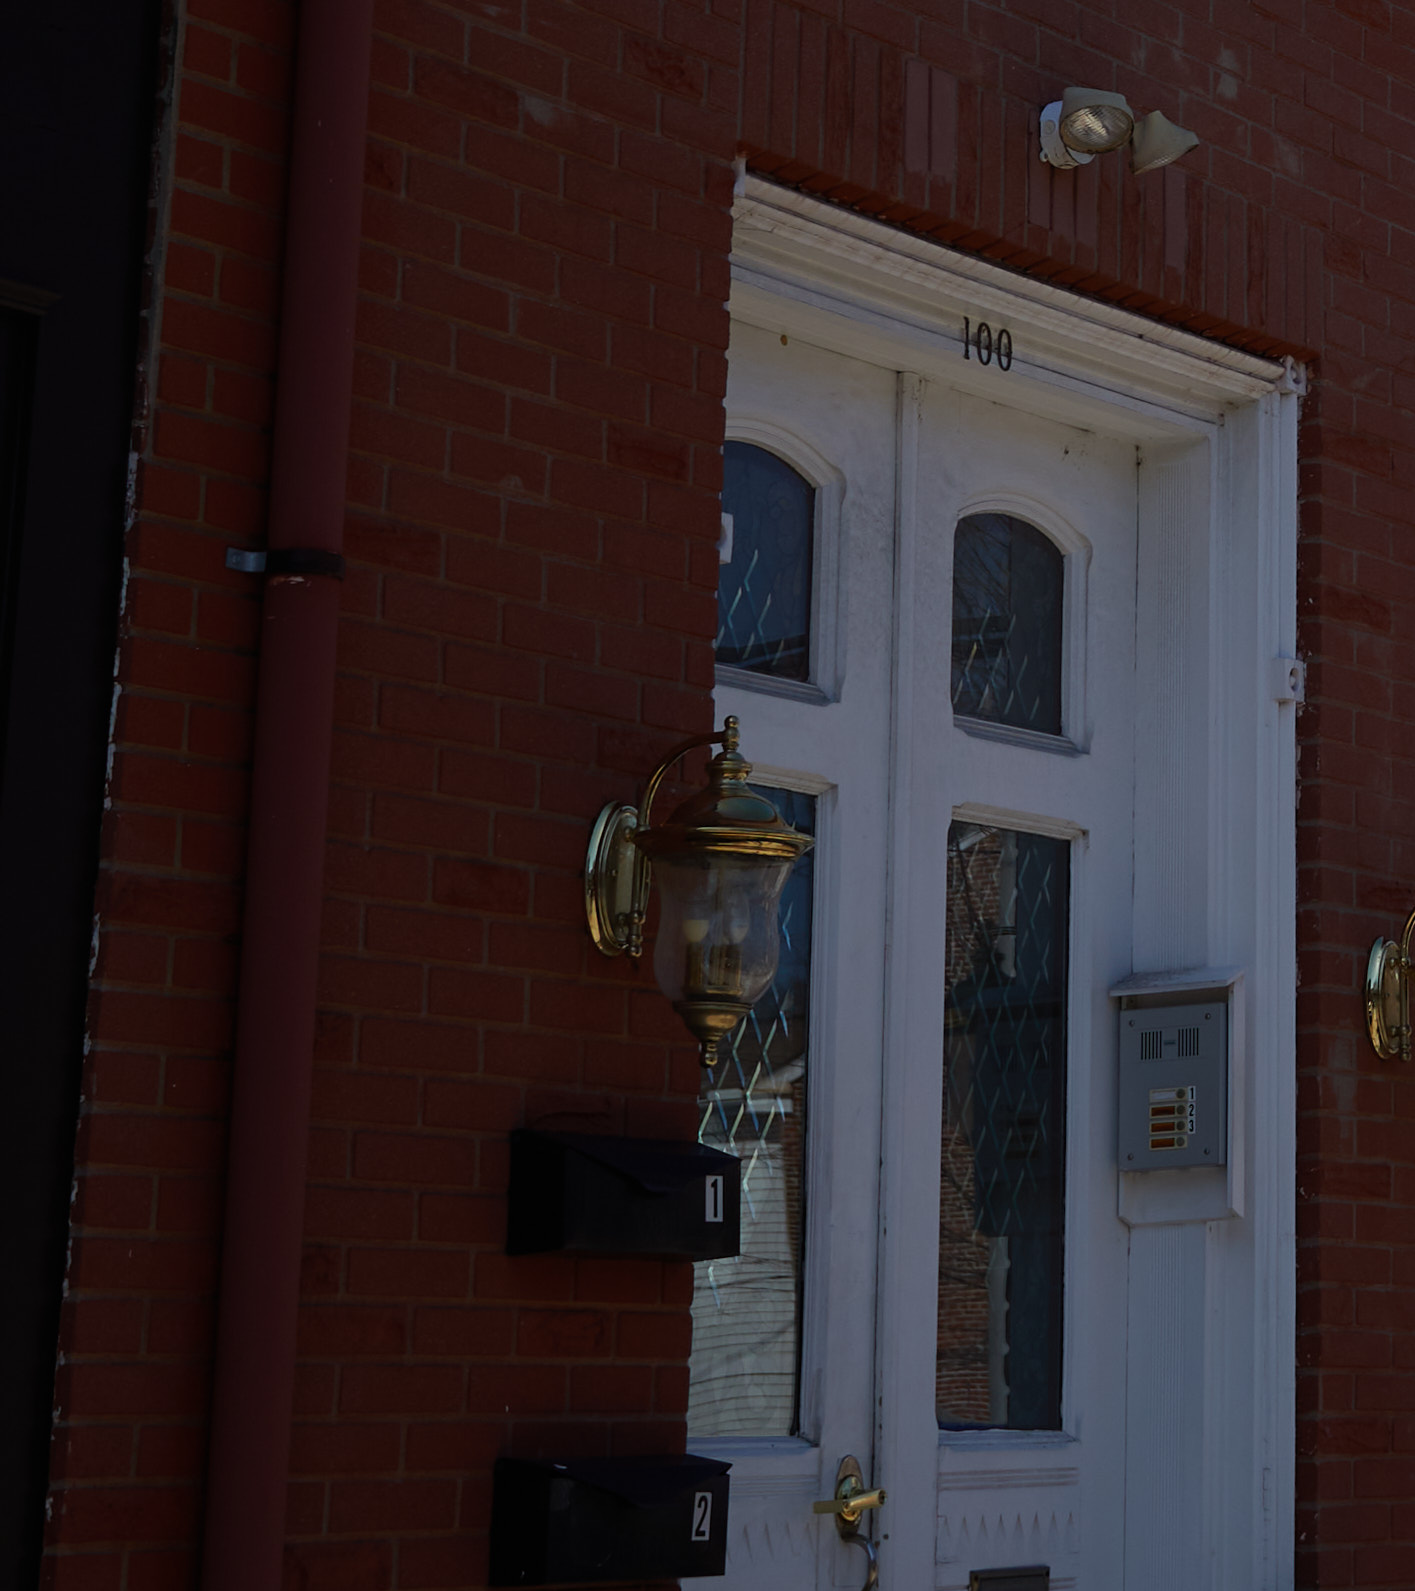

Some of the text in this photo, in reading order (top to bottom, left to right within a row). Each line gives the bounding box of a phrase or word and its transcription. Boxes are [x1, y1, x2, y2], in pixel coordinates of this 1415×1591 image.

[963, 316, 1012, 371] 100
[1188, 1103, 1194, 1117] 2
[1188, 1119, 1194, 1132] 3
[710, 1177, 718, 1219] 1
[694, 1495, 708, 1537] 2
